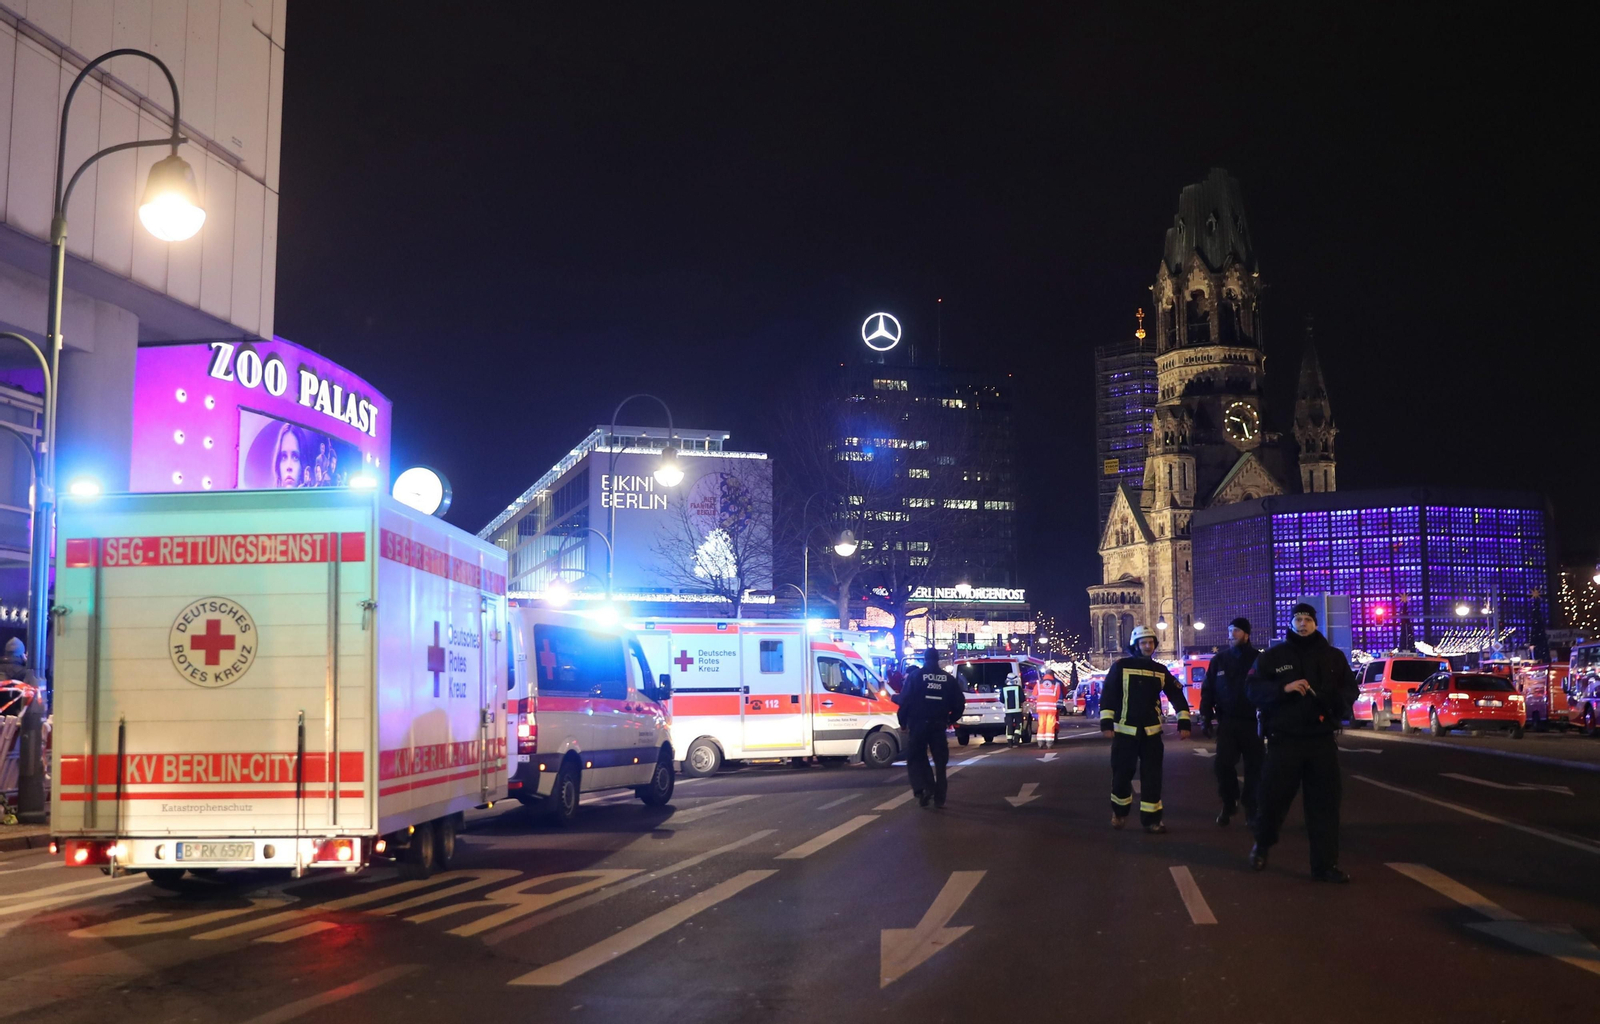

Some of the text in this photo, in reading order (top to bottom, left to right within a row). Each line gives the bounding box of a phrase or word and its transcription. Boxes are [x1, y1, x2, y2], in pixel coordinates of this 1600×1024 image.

[211, 342, 378, 437] ZOO PALAST
[602, 492, 667, 510] BERLIN
[106, 538, 143, 565] SEG
[159, 534, 324, 564] RETTUNGSDIENST
[176, 601, 251, 634] DEUTSCHES
[449, 625, 480, 649] Deutsches
[173, 644, 253, 683] ROTES KREUZ
[449, 650, 467, 673] Rotes
[449, 676, 467, 698] Kreuz
[922, 673, 947, 682] POLIZEI
[764, 699, 779, 708] 112
[126, 753, 297, 782] KV BERLIN-CITY
[161, 802, 253, 813] Katastrophenschutz
[184, 844, 253, 858] B RK 6597
